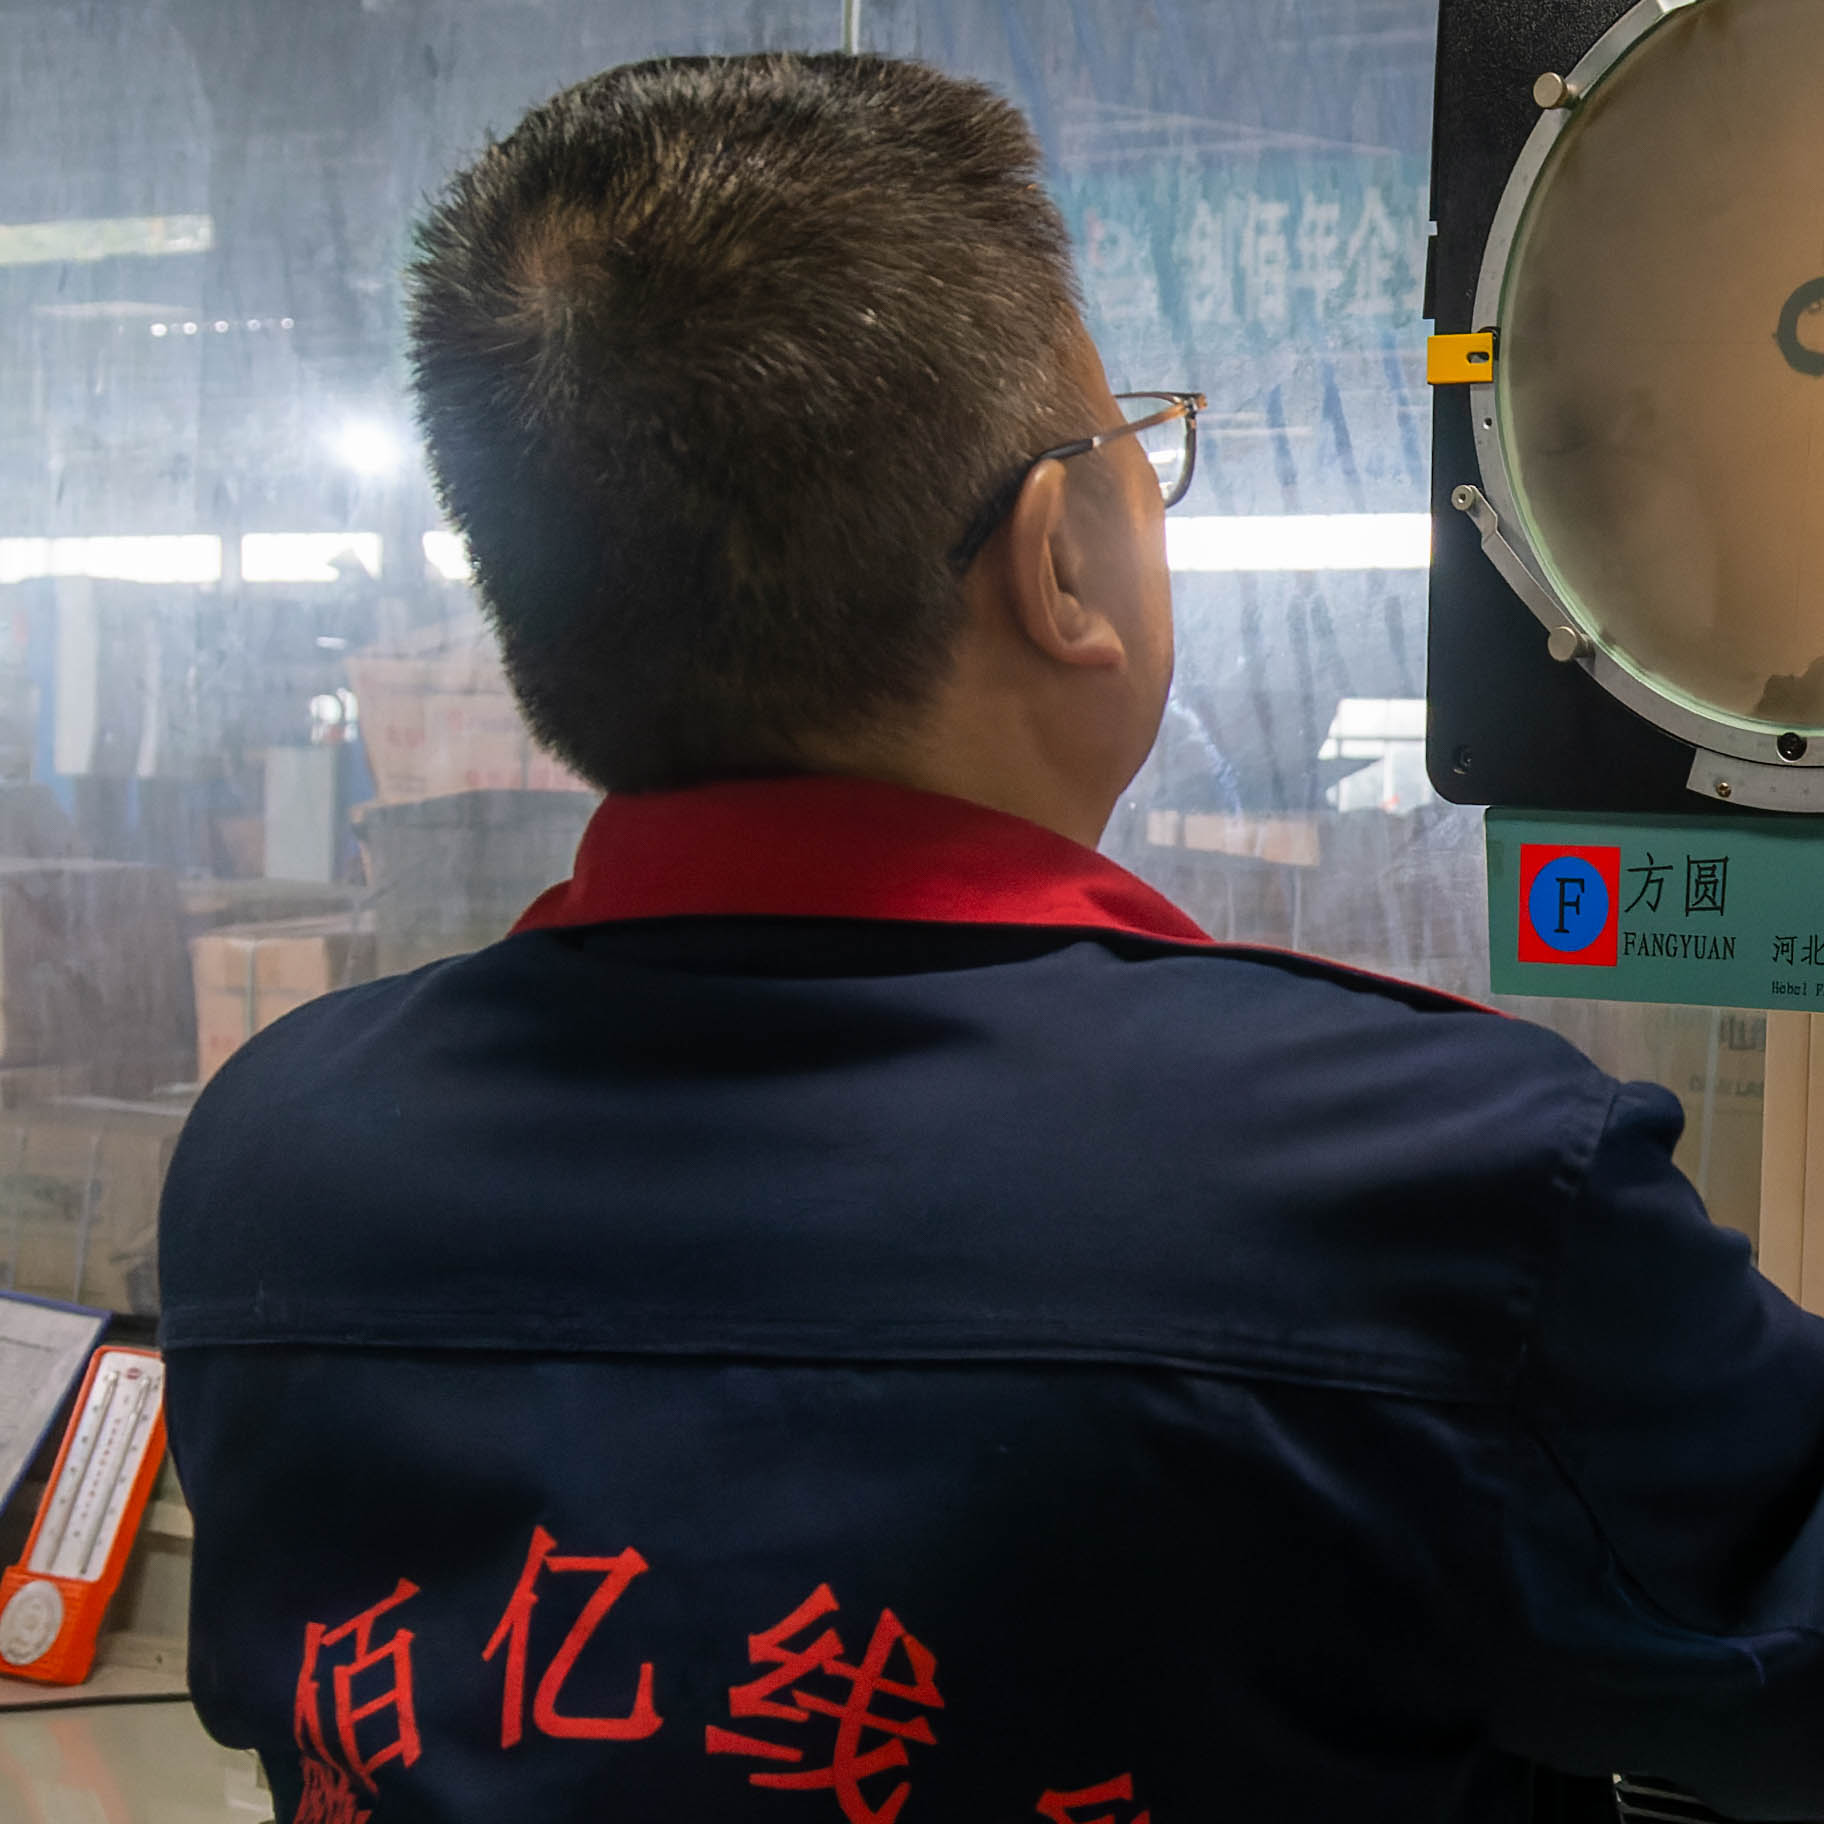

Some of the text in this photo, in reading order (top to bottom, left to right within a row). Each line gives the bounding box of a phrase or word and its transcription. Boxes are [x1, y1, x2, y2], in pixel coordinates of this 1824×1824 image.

[1553, 876, 1586, 935] F
[1625, 851, 1730, 918] 方圆
[1623, 929, 1737, 962] FANGYUAN
